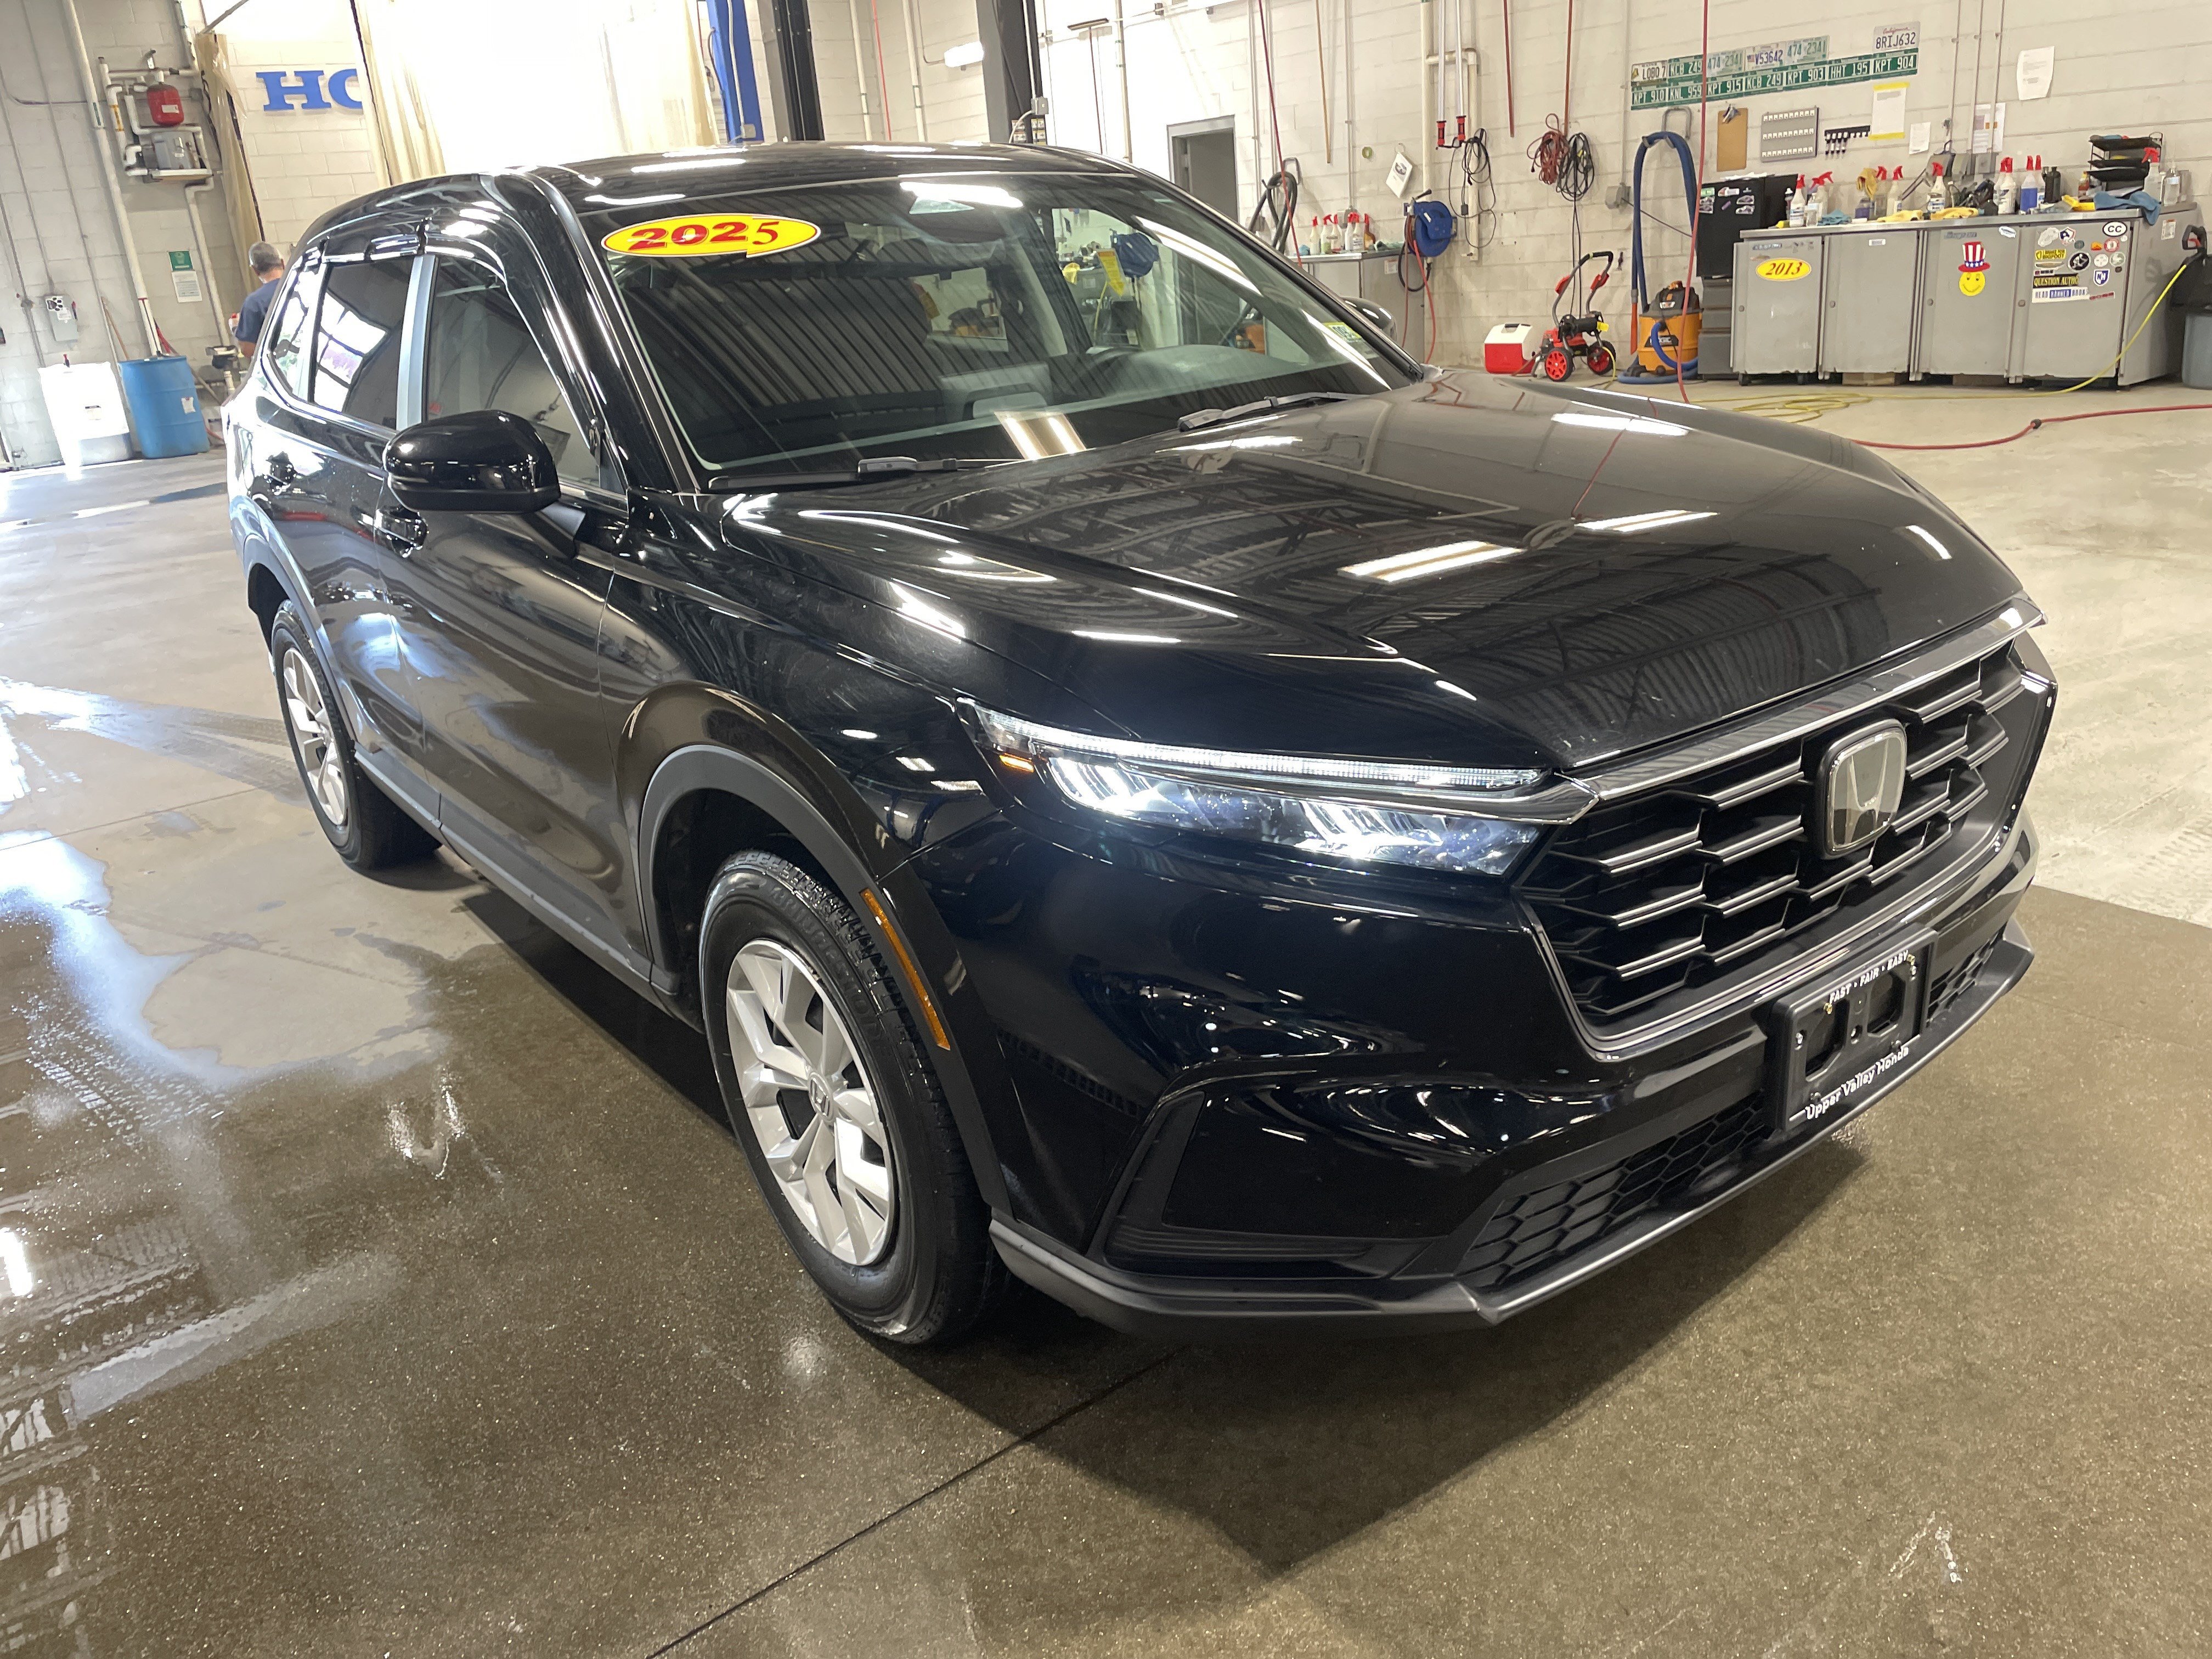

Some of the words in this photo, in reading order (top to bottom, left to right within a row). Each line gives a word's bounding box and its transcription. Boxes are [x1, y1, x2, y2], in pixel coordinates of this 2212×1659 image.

[1875, 31, 1916, 49] 8RIJ632
[1755, 49, 1784, 65] V53642
[1787, 43, 1802, 57] 474
[1688, 60, 1702, 74] 249
[1830, 64, 1847, 80] HHT
[1851, 61, 1868, 76] 195
[1875, 58, 1892, 73] KPT
[1897, 55, 1914, 70] 904
[1747, 76, 1762, 89] KCB
[1766, 72, 1781, 87] 249
[1787, 70, 1803, 84] KPT
[1808, 67, 1824, 82] 903
[1687, 84, 1702, 98] 959
[1707, 82, 1722, 95] KPT
[1726, 78, 1742, 93] 915
[1633, 92, 1647, 105] KPT
[1650, 89, 1665, 103] 910
[628, 221, 780, 251] 2025
[2107, 225, 2122, 233] CC
[1765, 261, 1803, 275] 2013
[2034, 276, 2059, 287] QUESTION
[1829, 981, 1853, 1005] FAST
[1859, 966, 1880, 988] FAIR
[1886, 950, 1909, 971] EASY
[1804, 1090, 1842, 1120] Upper
[1840, 1068, 1875, 1098] Valley
[1875, 1045, 1910, 1075] Honda
